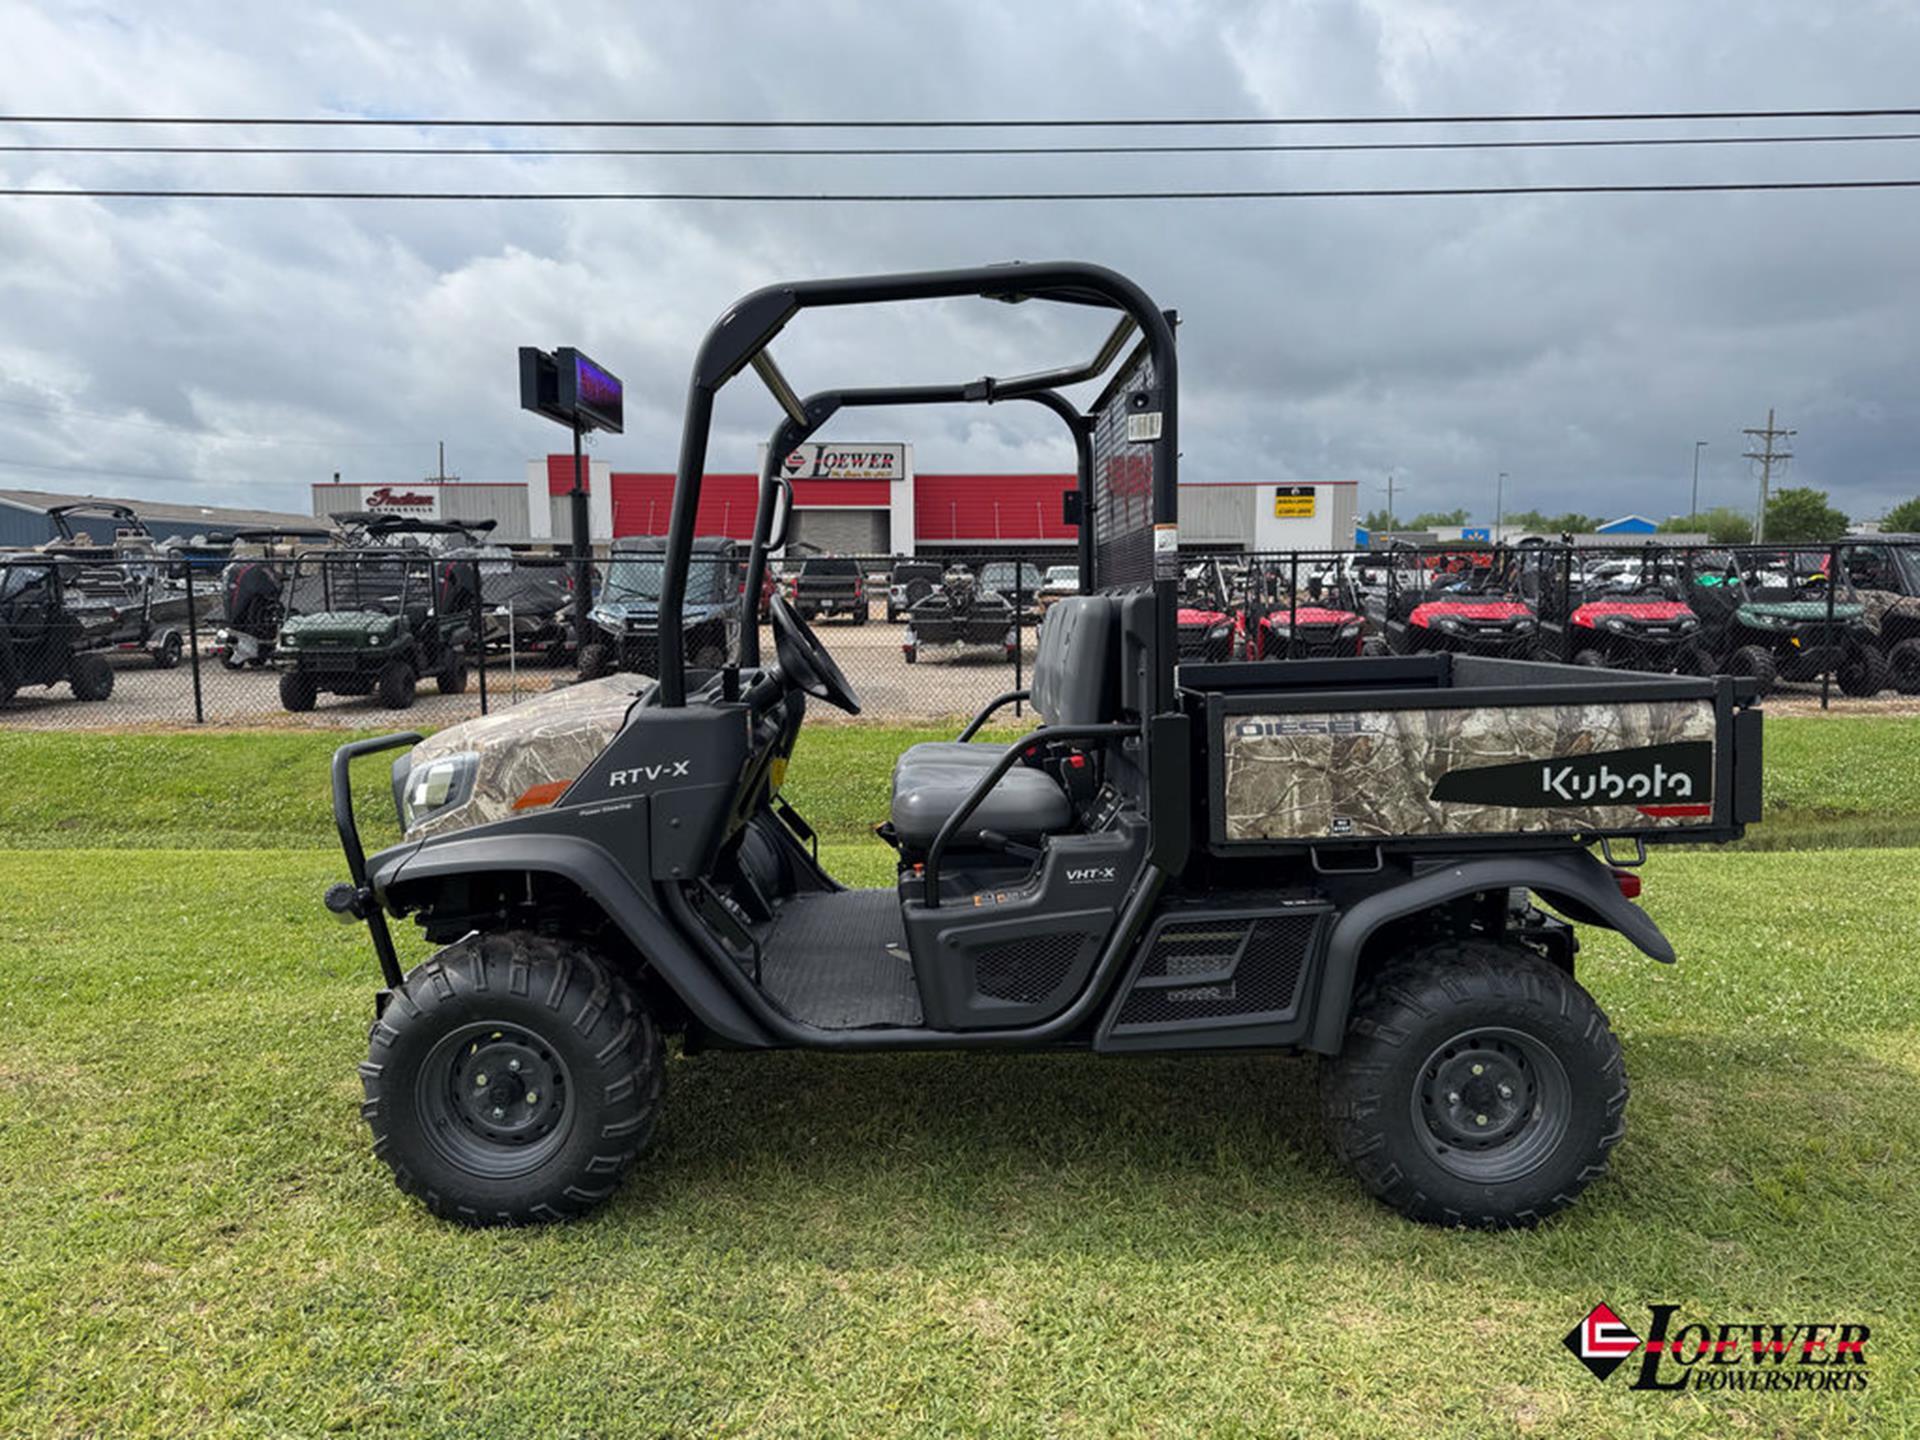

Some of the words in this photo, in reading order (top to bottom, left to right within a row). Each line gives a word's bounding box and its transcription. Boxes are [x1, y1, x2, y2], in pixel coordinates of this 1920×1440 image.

[811, 445, 895, 477] LOEWER
[366, 488, 434, 507] Indian
[1235, 720, 1378, 737] DIESEL
[609, 760, 690, 787] RTV-X
[1542, 763, 1693, 801] Kubota
[1066, 867, 1115, 880] VHT-X
